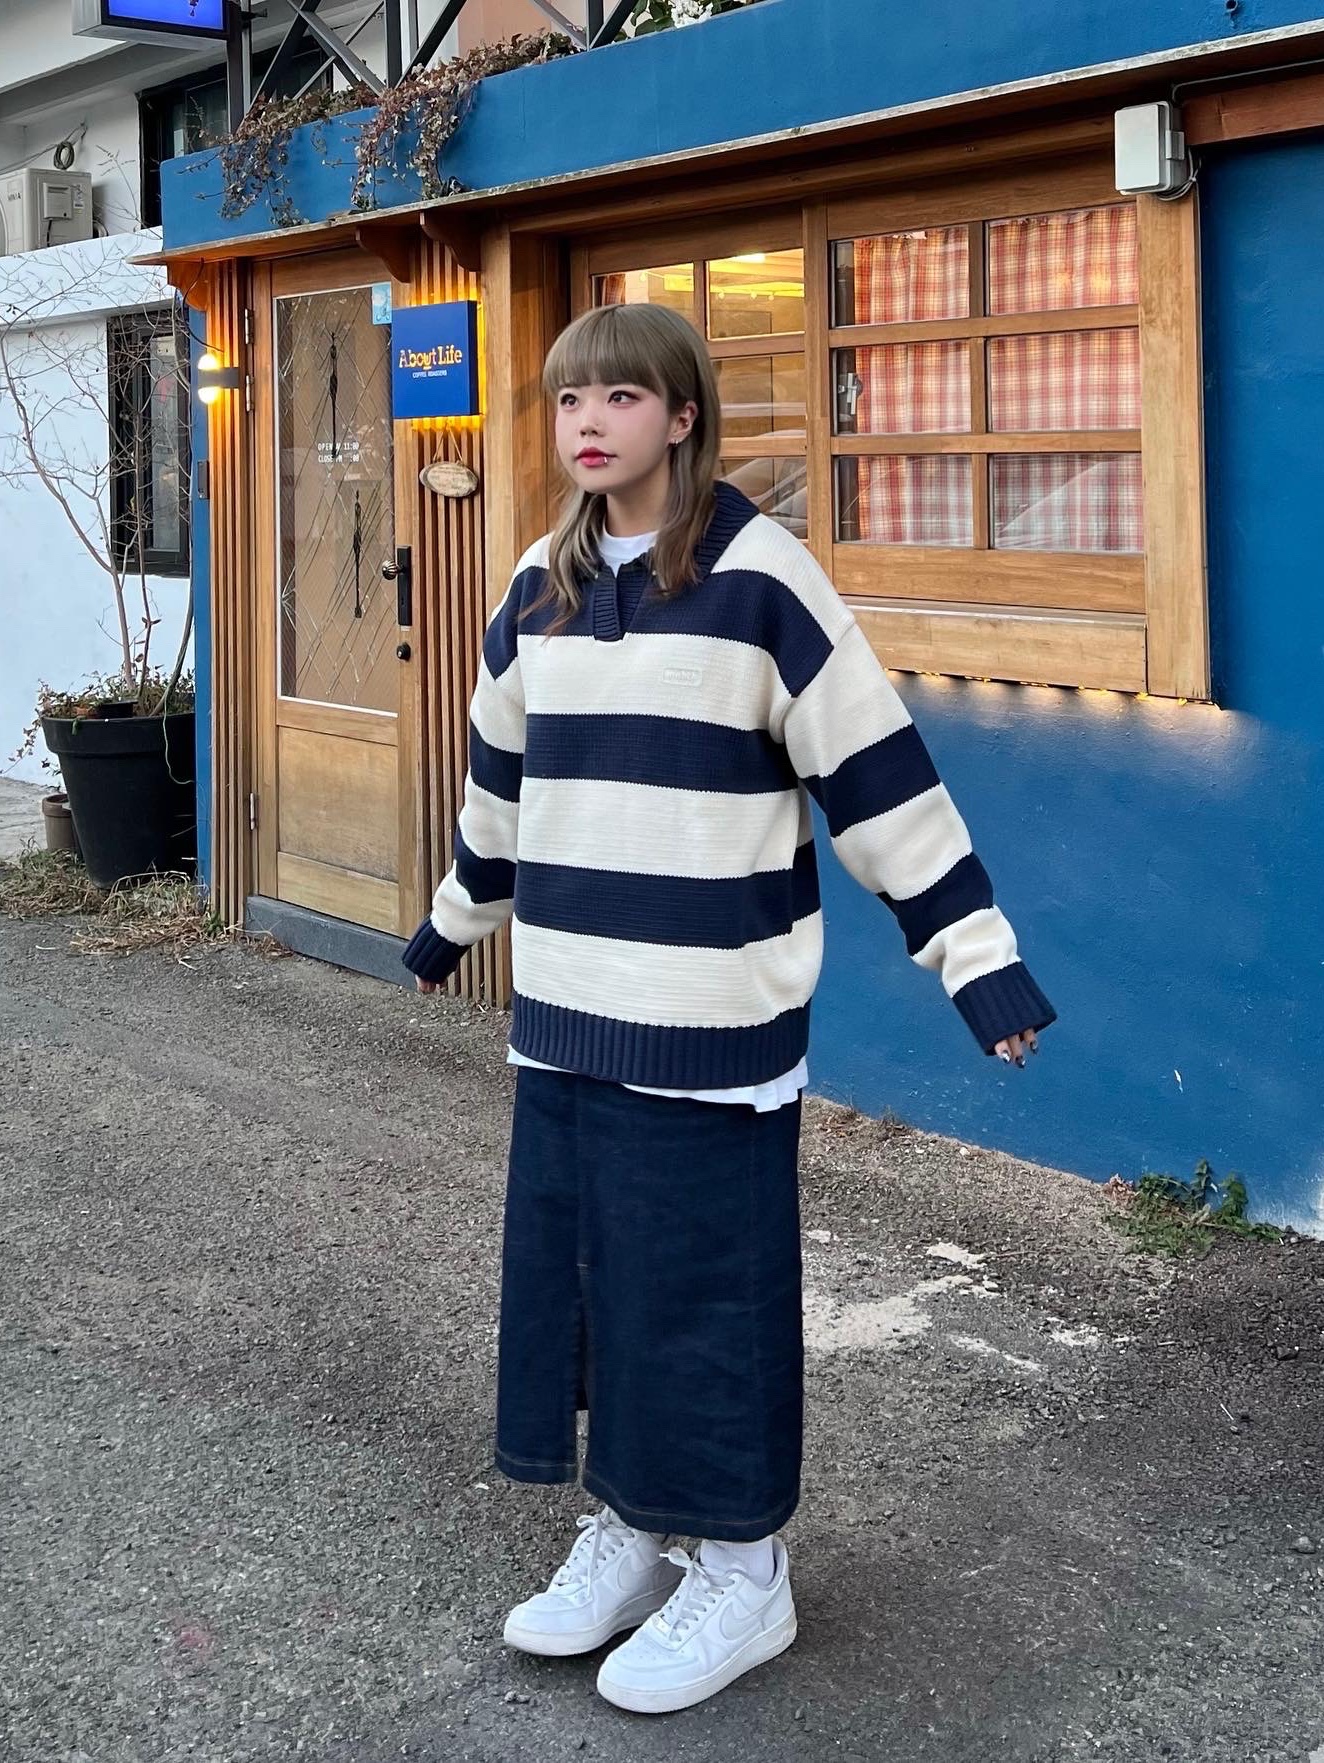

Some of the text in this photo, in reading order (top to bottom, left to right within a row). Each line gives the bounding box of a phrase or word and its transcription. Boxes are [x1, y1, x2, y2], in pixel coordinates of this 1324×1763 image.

[399, 344, 463, 368] About Life
[317, 442, 333, 451] OPEN
[317, 454, 333, 463] CLOSE
